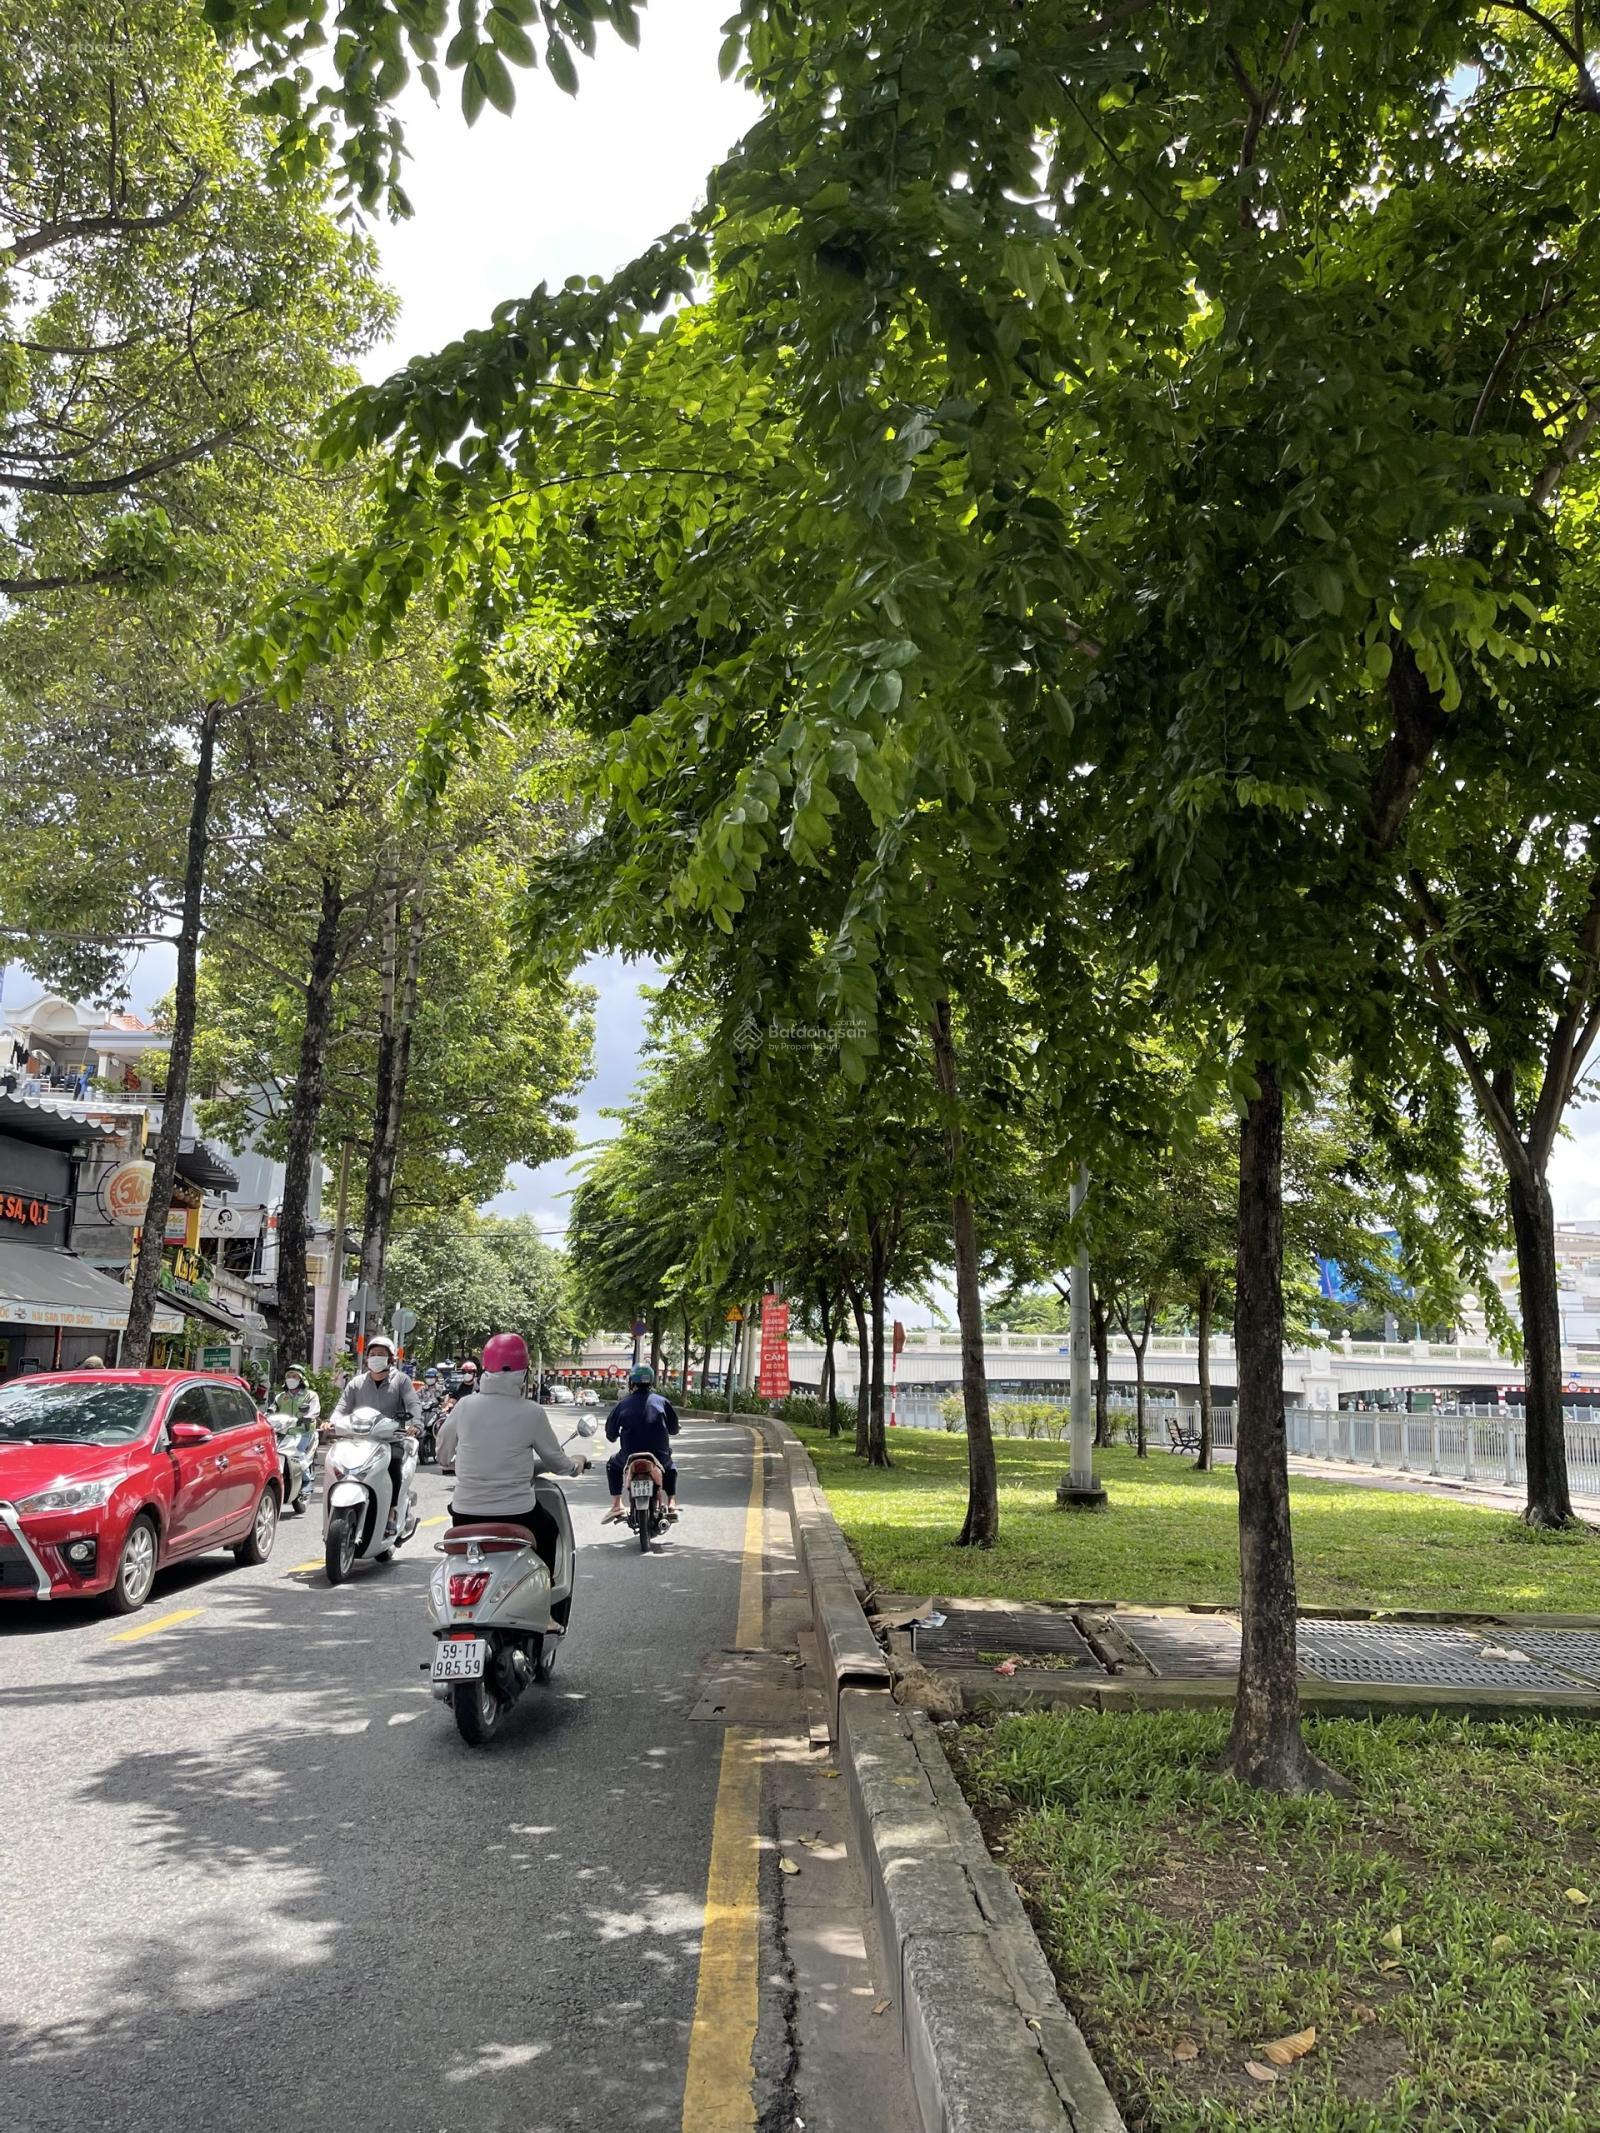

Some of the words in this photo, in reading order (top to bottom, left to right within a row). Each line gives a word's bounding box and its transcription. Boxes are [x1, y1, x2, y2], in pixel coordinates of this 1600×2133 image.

[6, 1196, 26, 1224] SA,
[29, 1201, 49, 1227] Q.1
[442, 1643, 477, 1659] 59-T1
